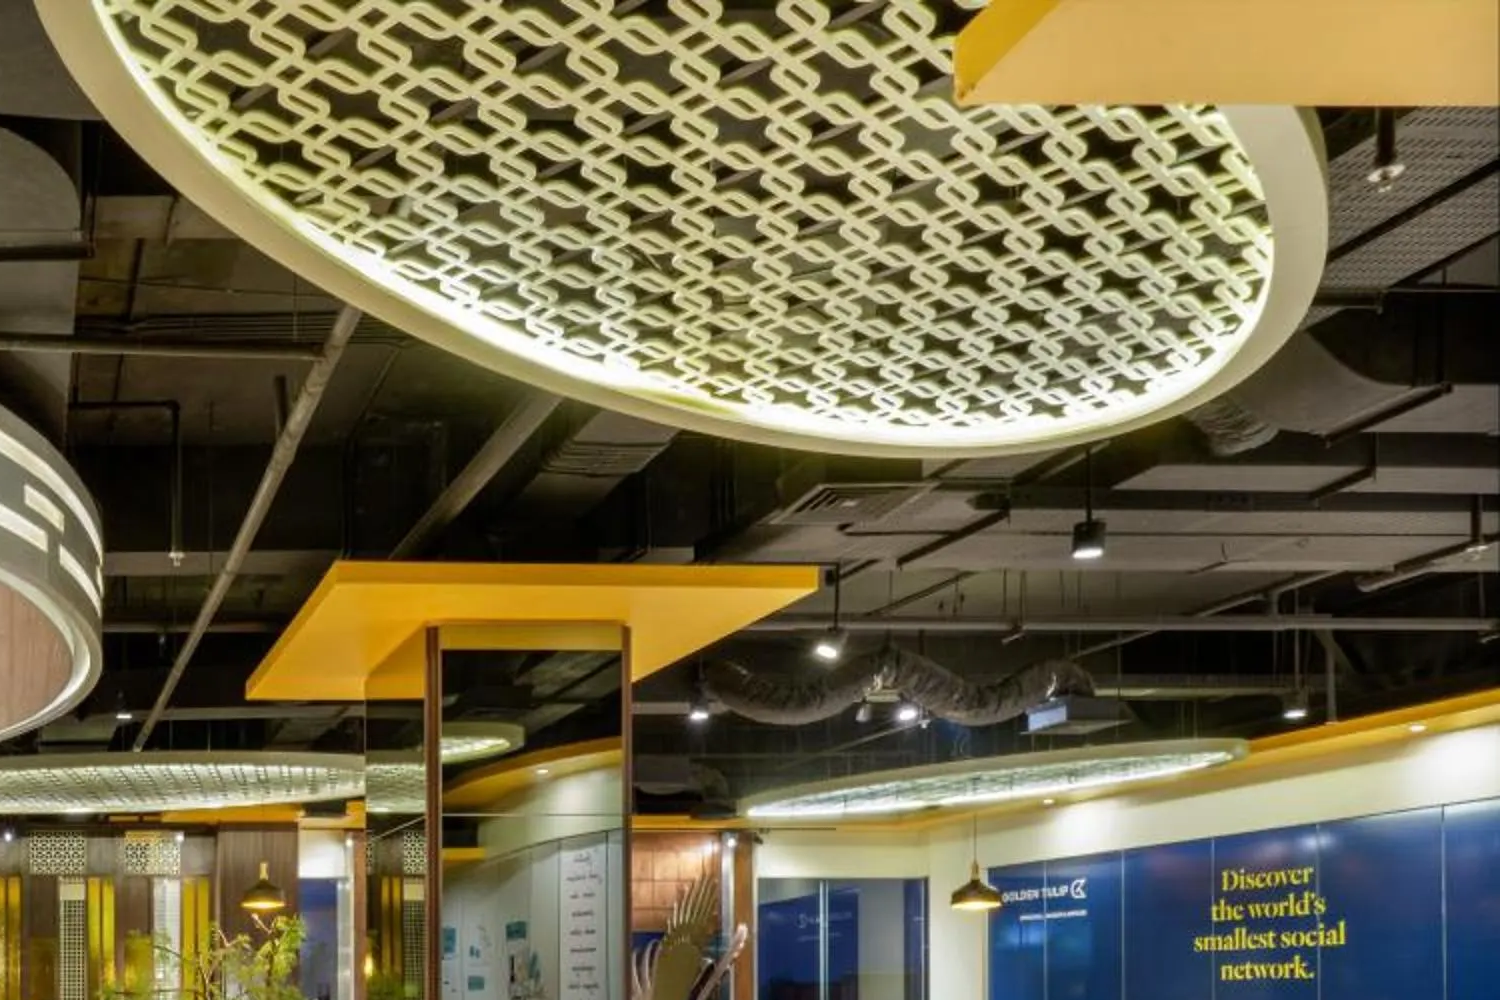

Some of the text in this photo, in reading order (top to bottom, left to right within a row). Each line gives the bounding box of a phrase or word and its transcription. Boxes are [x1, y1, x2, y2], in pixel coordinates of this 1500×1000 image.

[1222, 867, 1313, 891] Discover
[1041, 885, 1068, 899] TULIP
[1211, 899, 1244, 921] the
[1194, 919, 1345, 952] smallest social
[1221, 955, 1315, 980] network.
